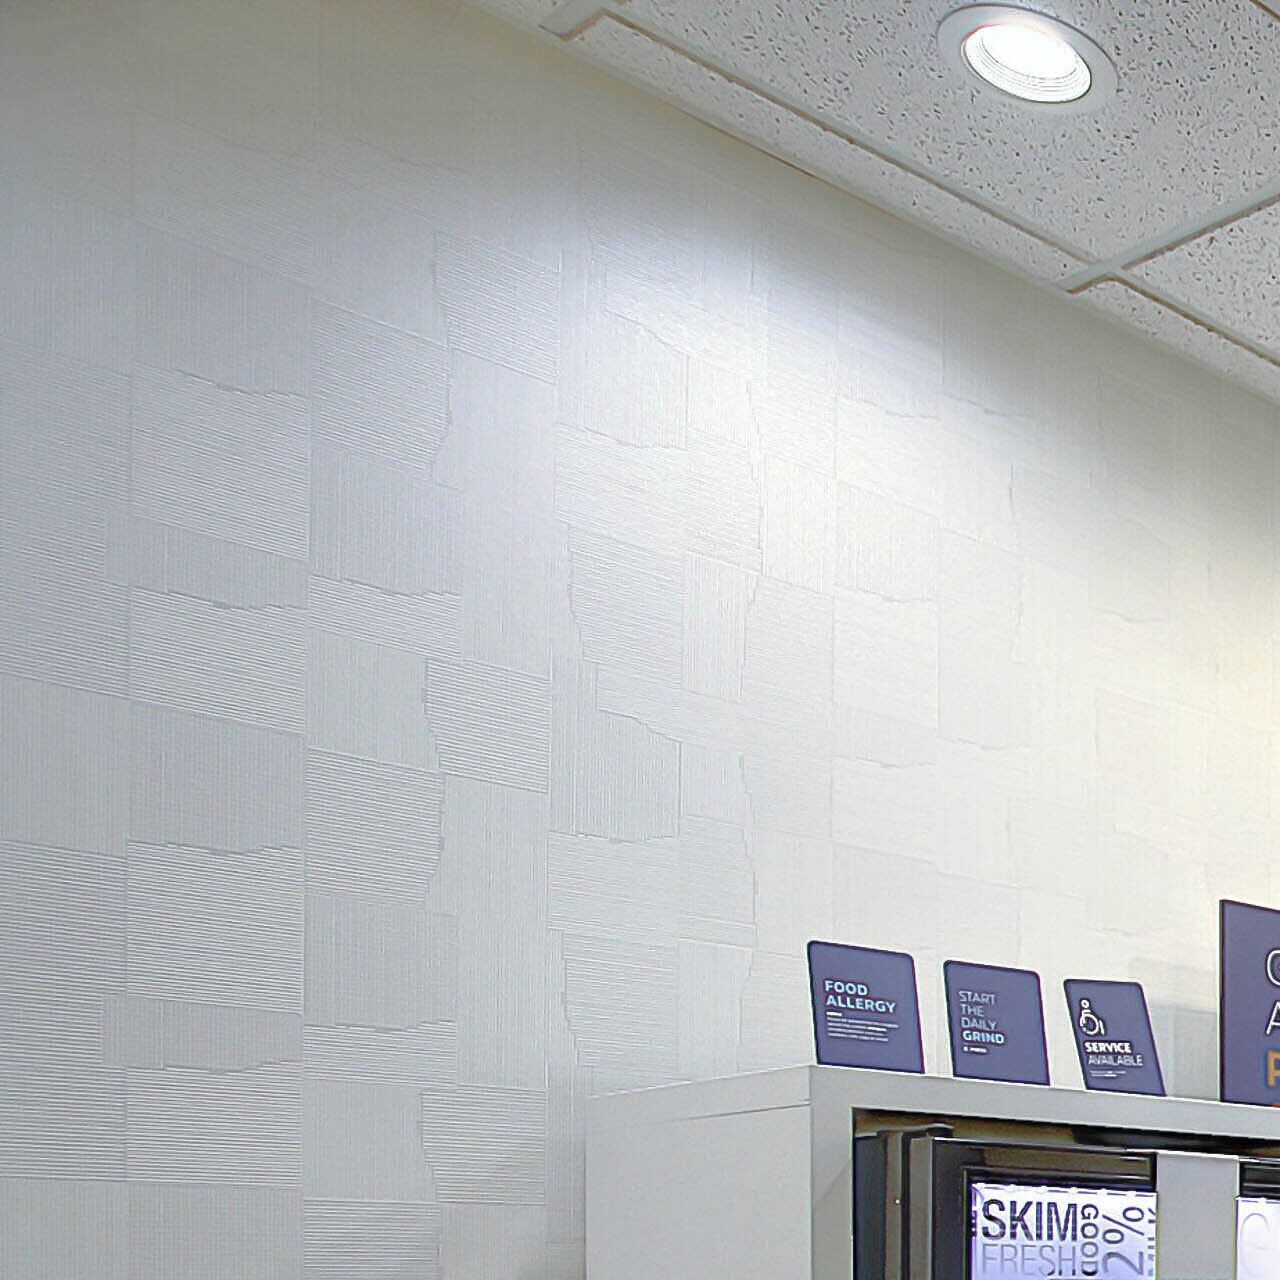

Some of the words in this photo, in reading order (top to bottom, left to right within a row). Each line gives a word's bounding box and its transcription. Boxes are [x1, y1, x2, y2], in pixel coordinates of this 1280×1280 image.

[825, 980, 868, 996] FOOD
[826, 994, 896, 1013] ALLERGY
[958, 990, 995, 1005] START
[960, 1003, 985, 1017] THE
[961, 1017, 997, 1031] DAILY
[962, 1030, 1005, 1044] GRIND
[1084, 1041, 1132, 1054] SERVICE
[1088, 1054, 1144, 1067] AVAILABLE
[982, 1199, 1078, 1242] SKIM
[1080, 1203, 1099, 1277] GOOD
[982, 1243, 1076, 1277] FRESH
